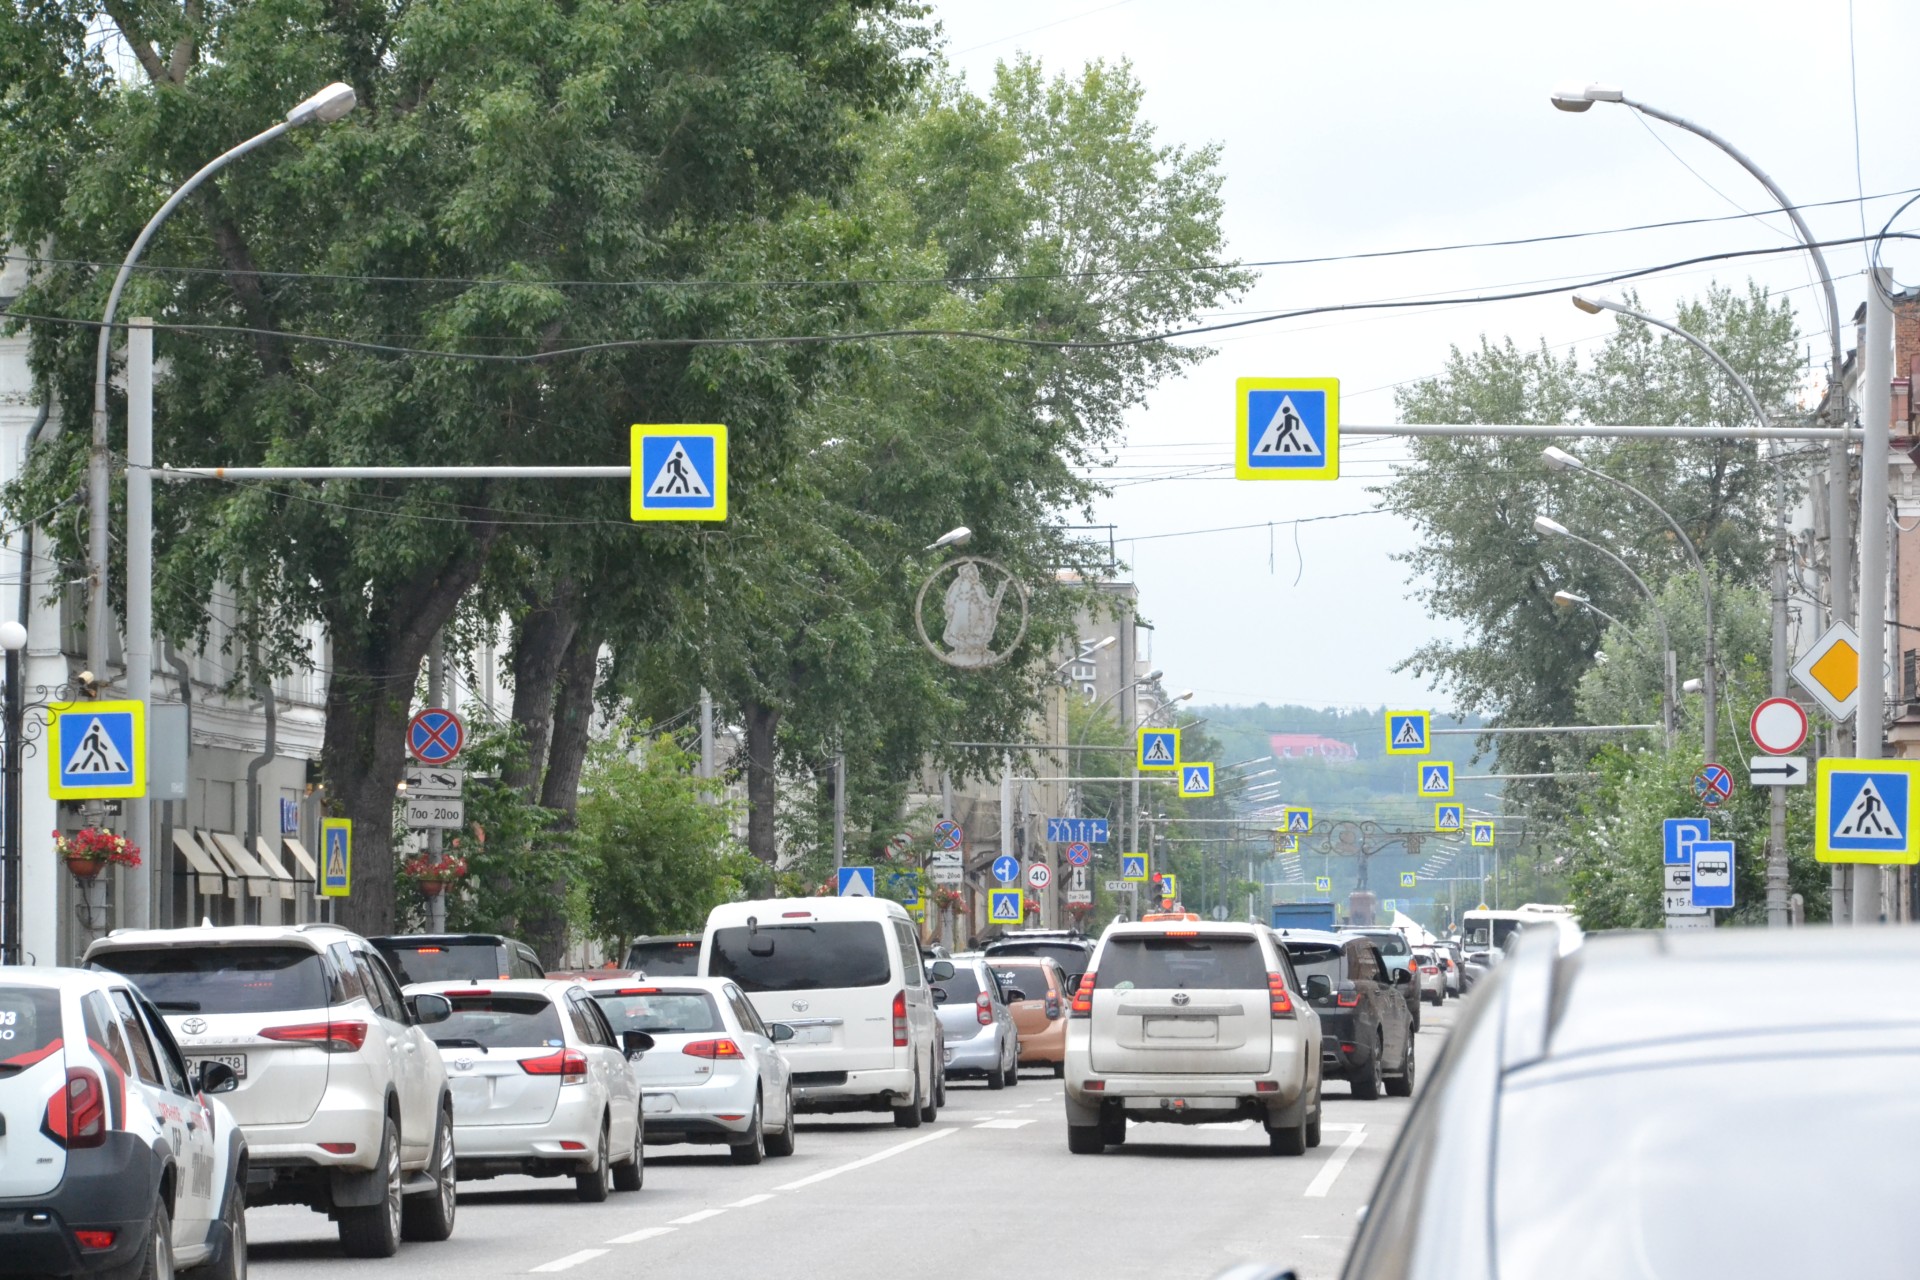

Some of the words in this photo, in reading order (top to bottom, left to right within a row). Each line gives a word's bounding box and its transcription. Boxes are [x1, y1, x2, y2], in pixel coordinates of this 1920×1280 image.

[1031, 870, 1047, 881] 40
[1108, 881, 1134, 890] СТОП
[1675, 897, 1685, 907] 15
